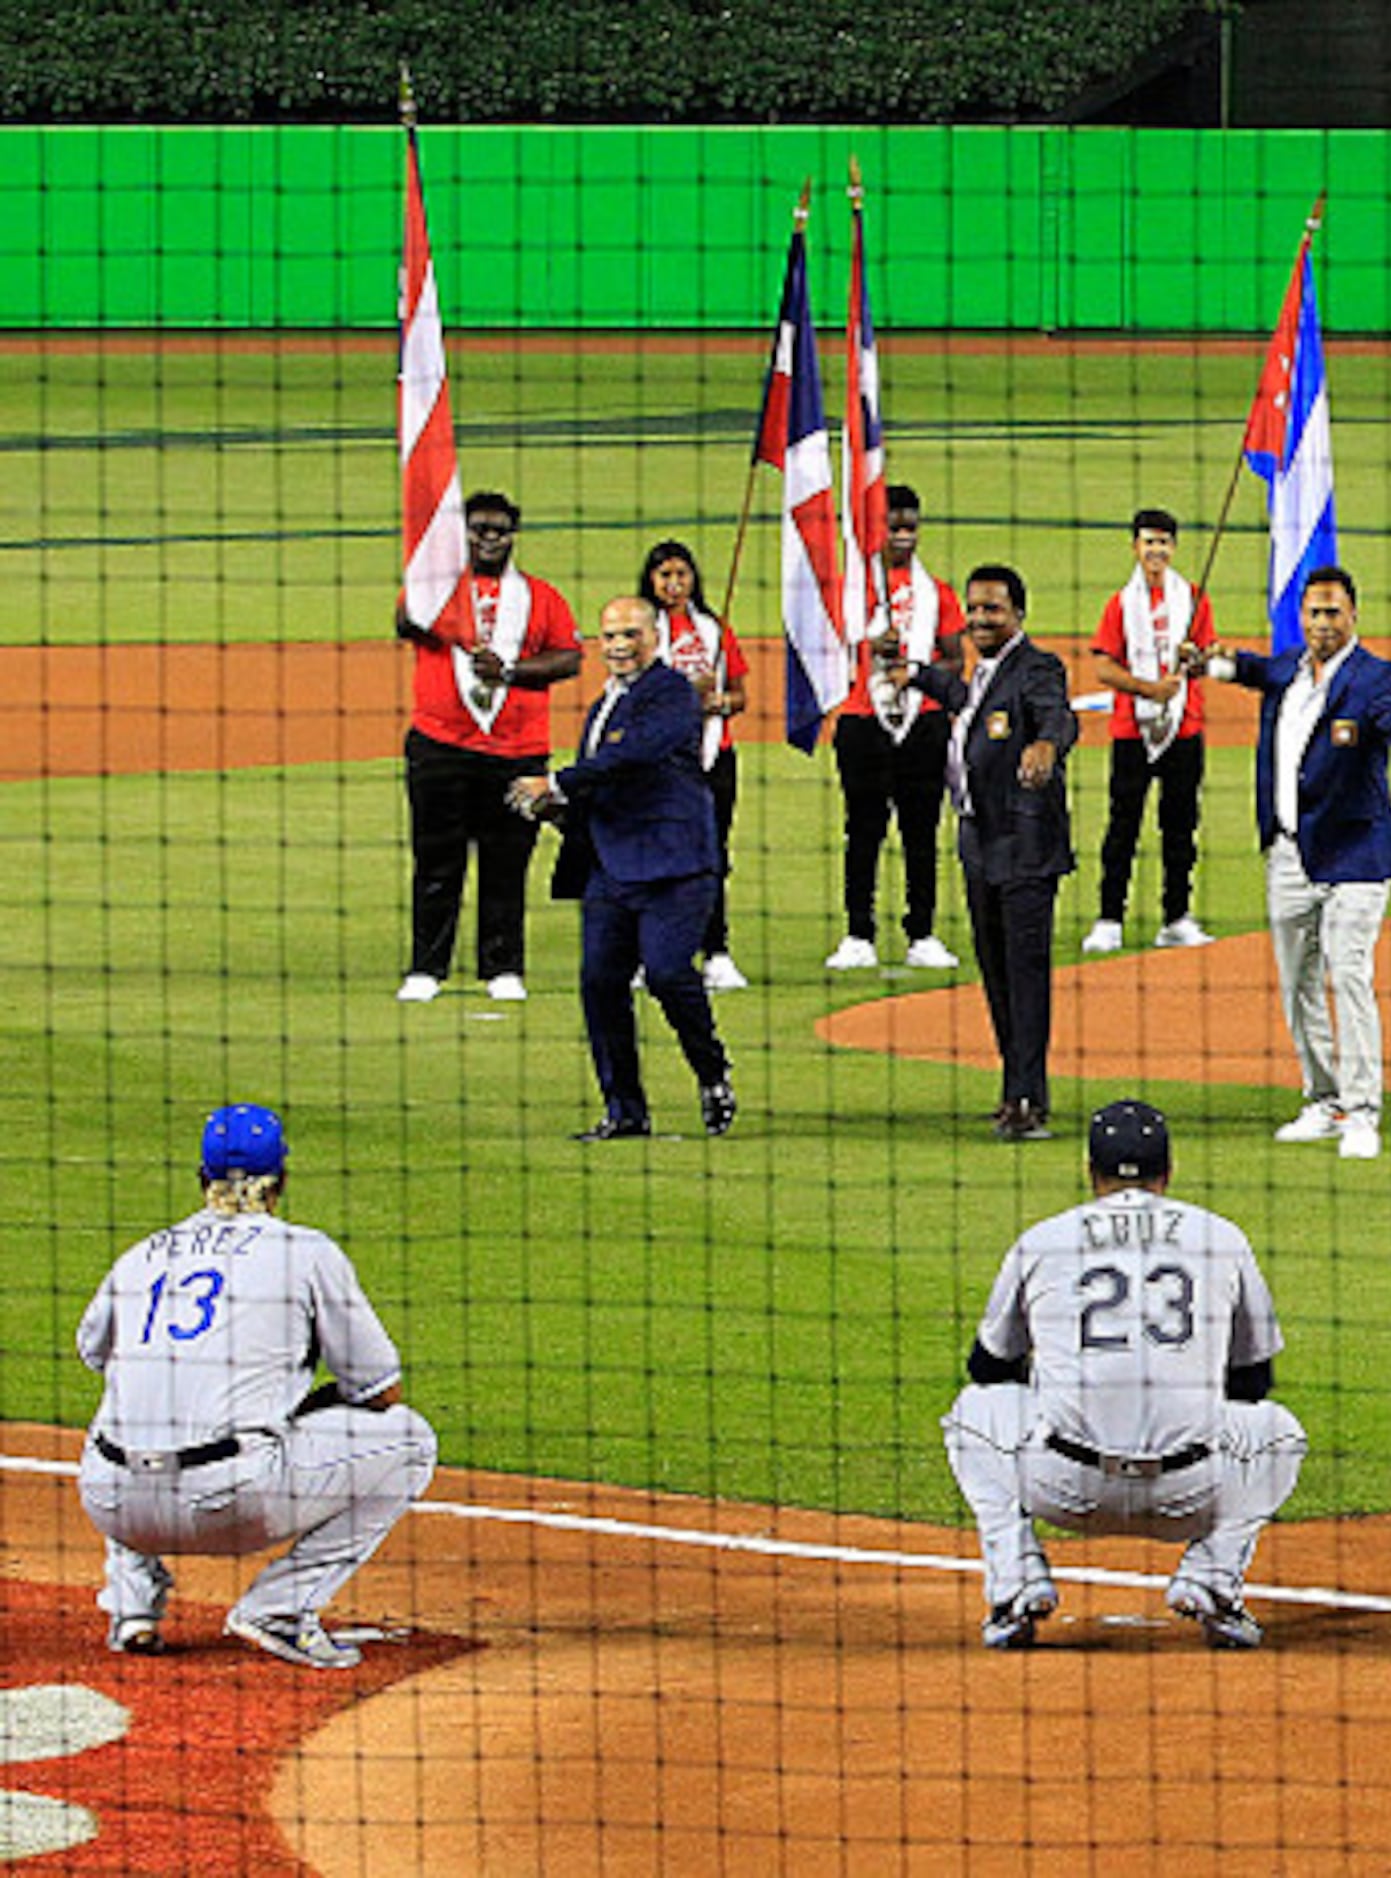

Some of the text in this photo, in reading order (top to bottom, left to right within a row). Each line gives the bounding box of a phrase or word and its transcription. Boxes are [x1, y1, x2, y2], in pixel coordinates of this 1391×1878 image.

[146, 1225, 264, 1263] PEREZ
[1082, 1208, 1186, 1248] CRUZ
[140, 1266, 226, 1345] 13
[1076, 1264, 1196, 1351] 23
